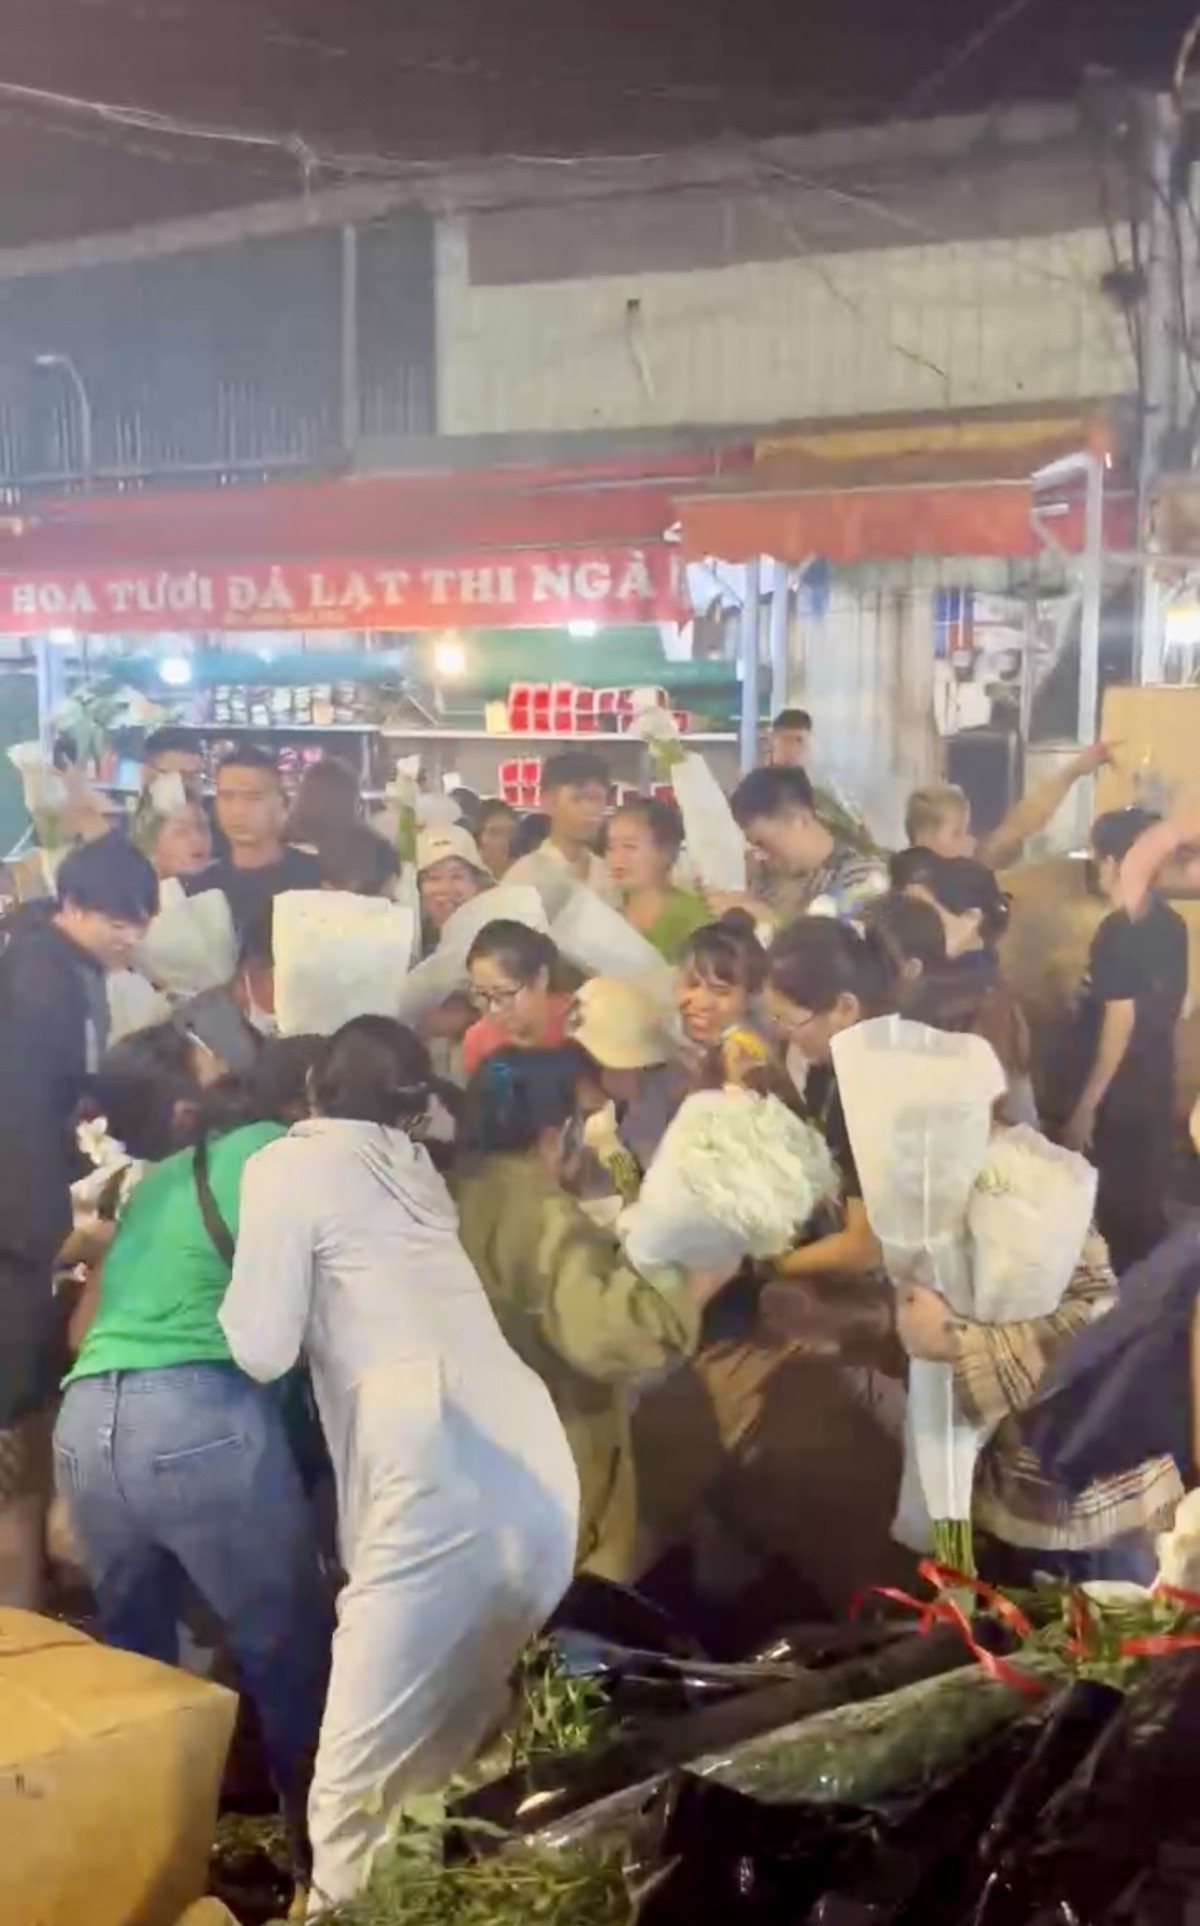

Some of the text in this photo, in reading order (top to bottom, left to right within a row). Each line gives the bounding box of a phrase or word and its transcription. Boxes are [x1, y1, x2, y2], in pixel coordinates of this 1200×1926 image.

[12, 582, 96, 614] HOA
[107, 571, 214, 612] TƯƠI
[309, 570, 408, 613] LẠT
[423, 566, 516, 605] THI
